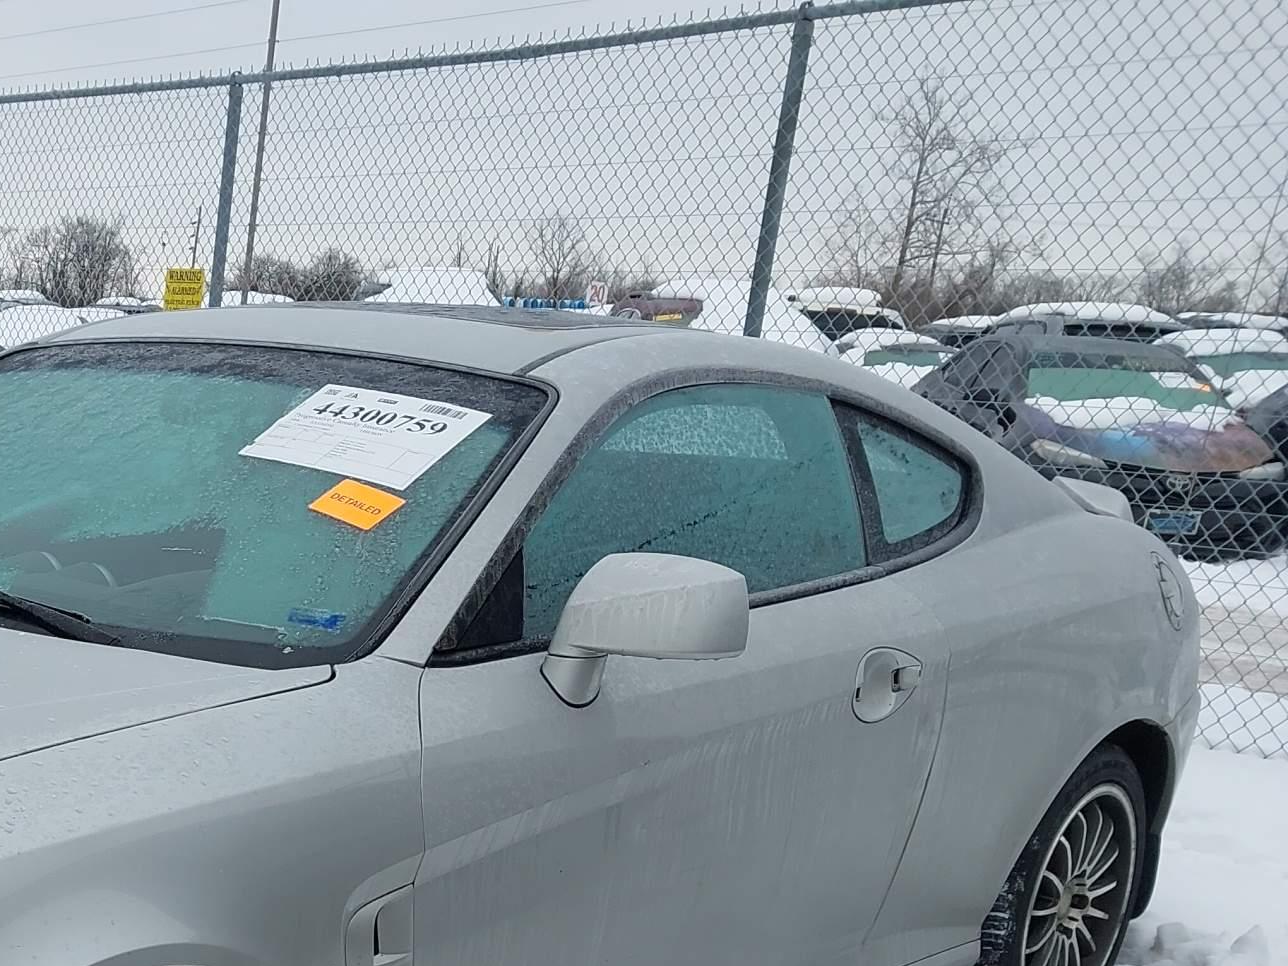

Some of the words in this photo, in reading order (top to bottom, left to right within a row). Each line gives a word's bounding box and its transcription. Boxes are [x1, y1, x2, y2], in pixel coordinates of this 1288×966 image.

[169, 270, 201, 281] WARNING
[313, 402, 448, 435] 44300759
[330, 492, 382, 516] DETAILED
